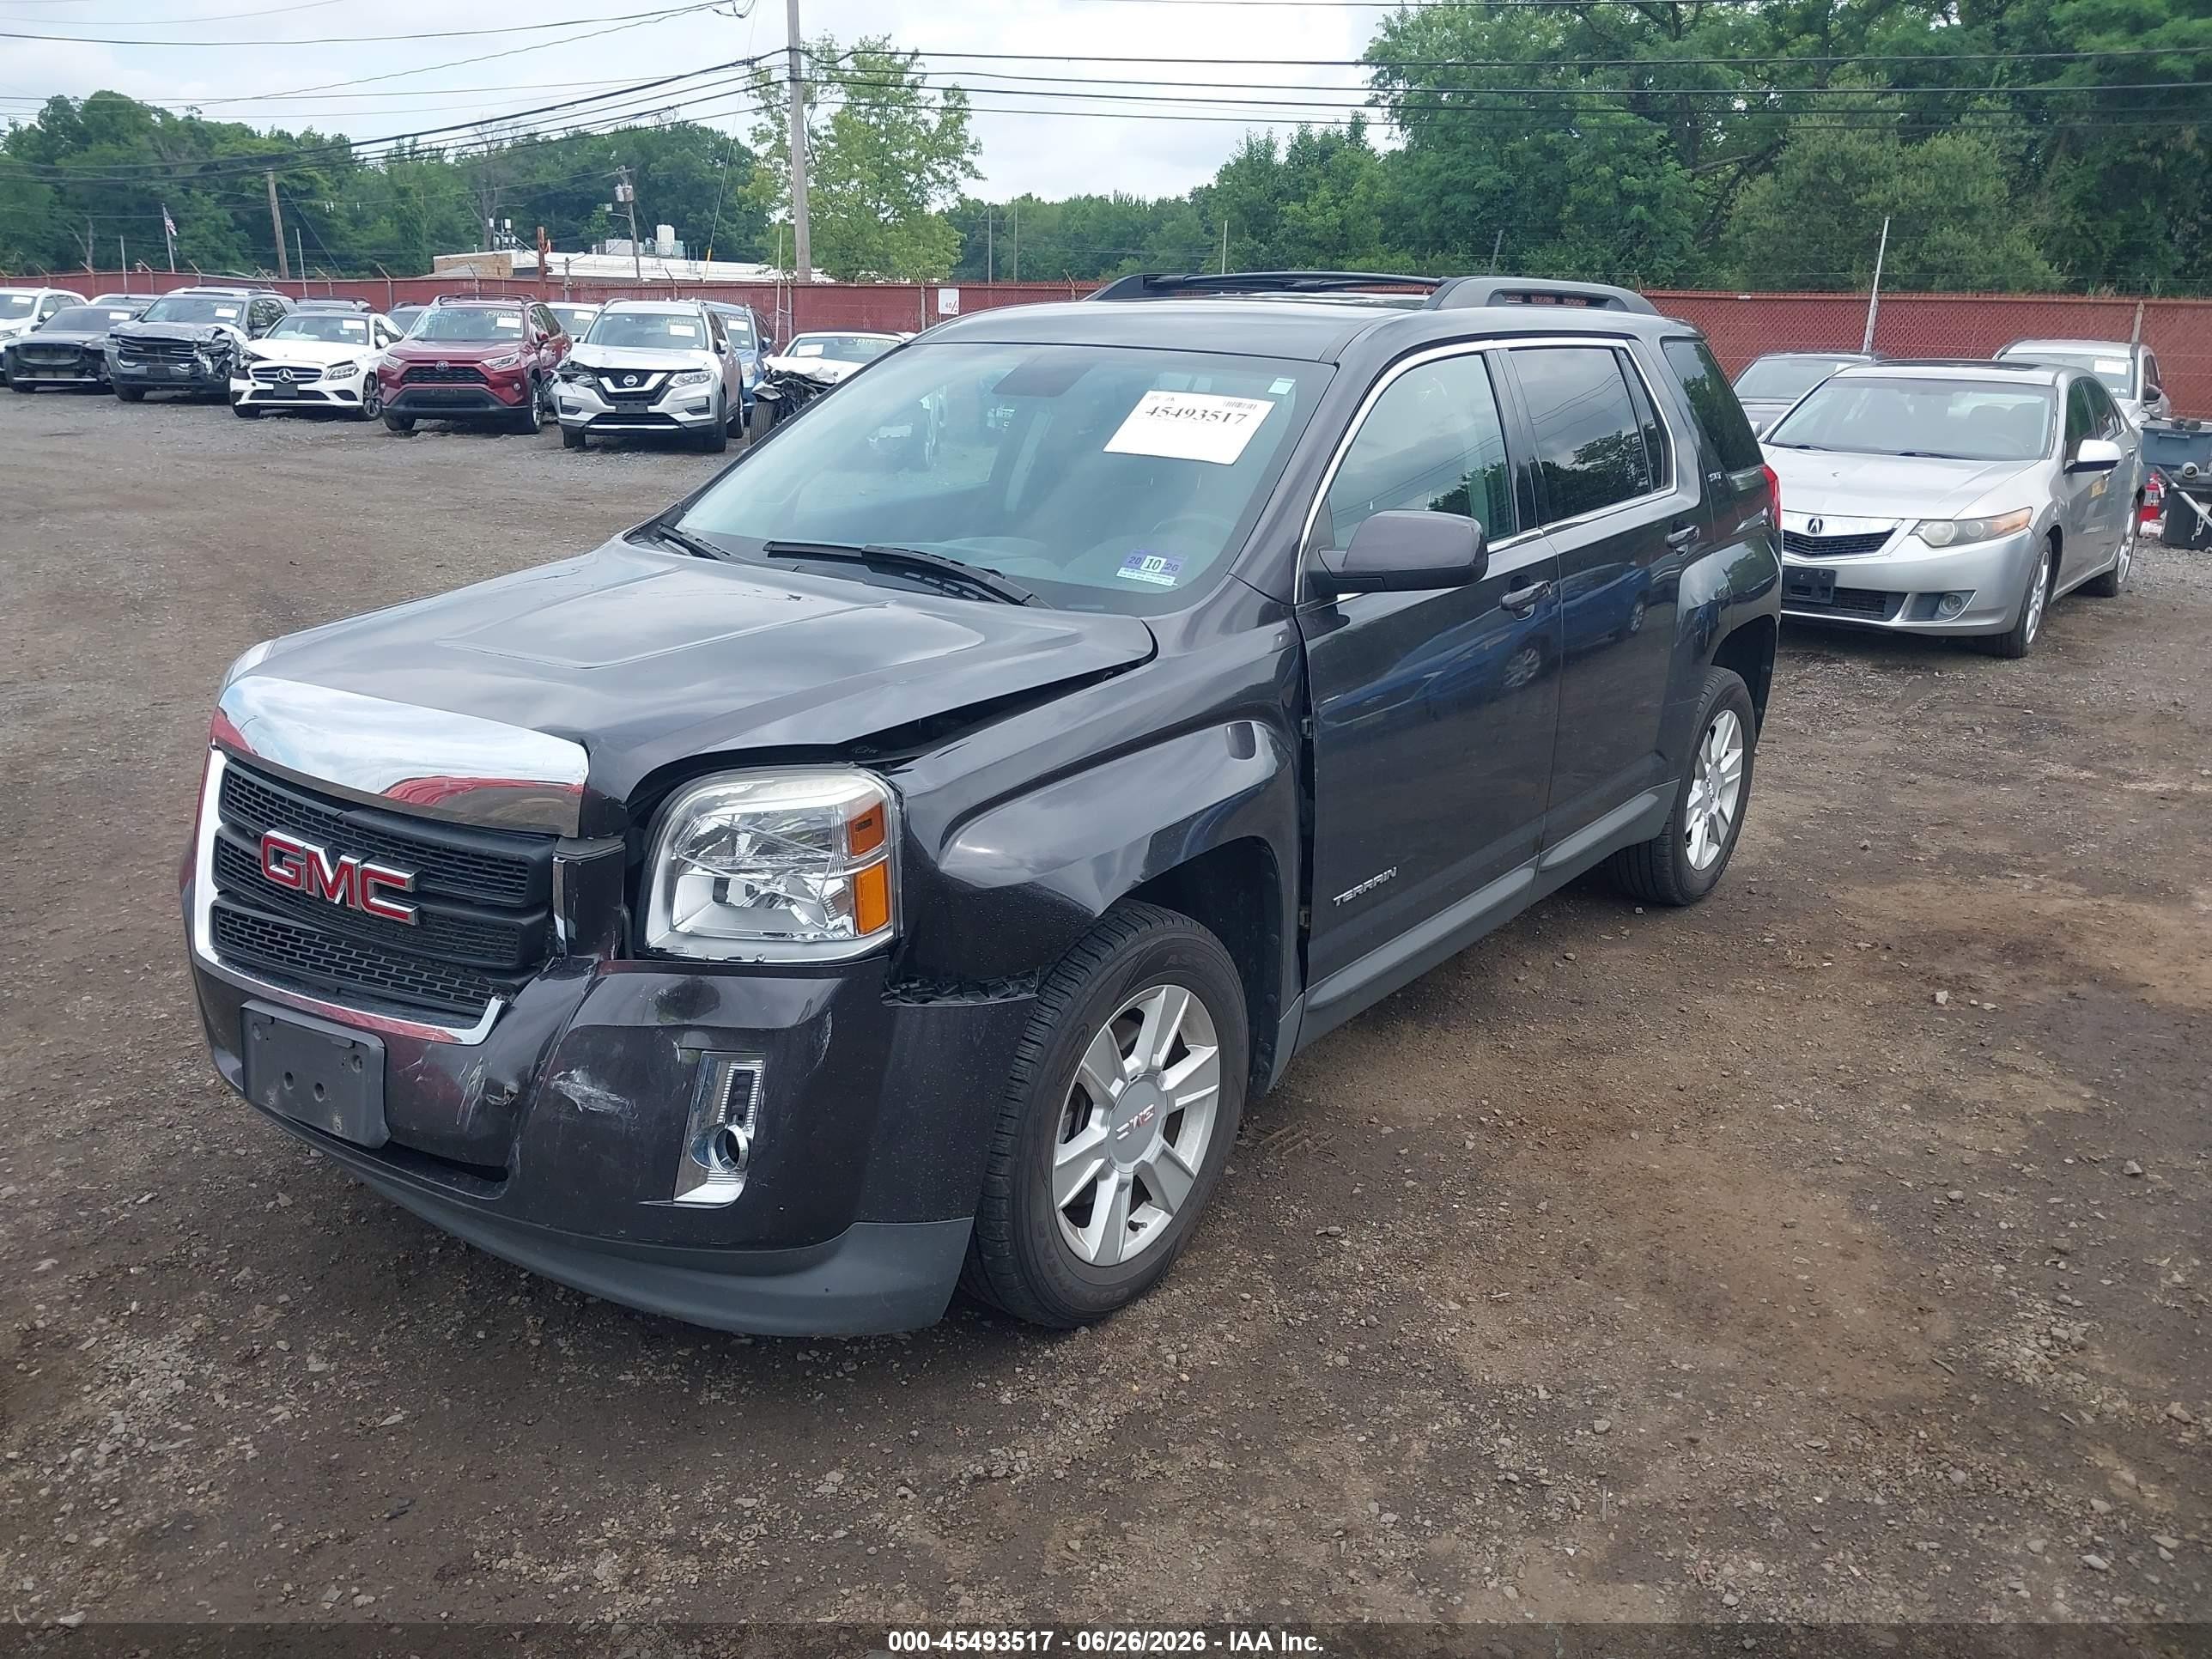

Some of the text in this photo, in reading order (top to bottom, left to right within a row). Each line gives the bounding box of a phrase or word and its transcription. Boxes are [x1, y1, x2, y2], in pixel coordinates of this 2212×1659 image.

[1146, 405, 1249, 425] 45493517
[1127, 556, 1142, 565] 20
[1144, 557, 1162, 571] 10
[261, 829, 423, 927] GMC
[1333, 866, 1397, 907] TERRAIN
